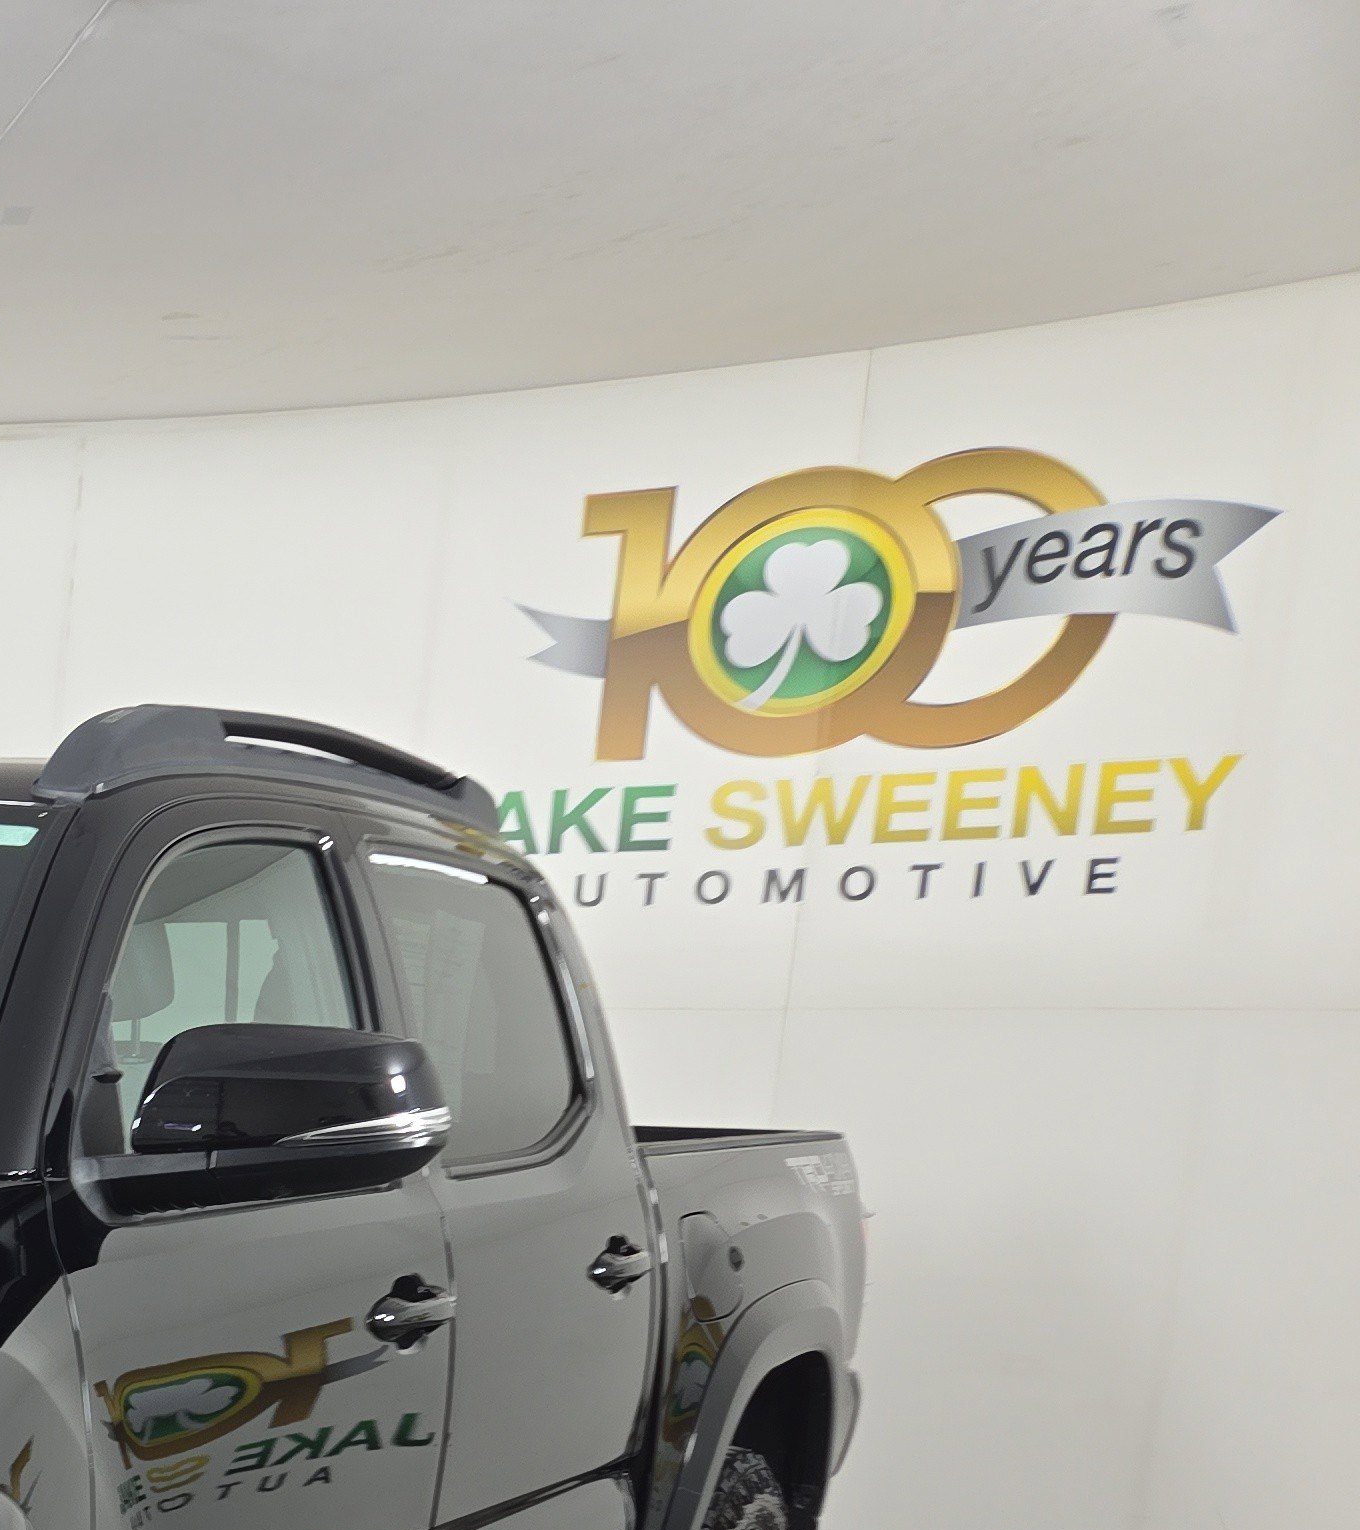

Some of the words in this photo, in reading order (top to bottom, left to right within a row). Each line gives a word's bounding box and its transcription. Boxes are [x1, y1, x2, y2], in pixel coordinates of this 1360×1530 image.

[582, 446, 1117, 762] 100
[971, 516, 1203, 613] years
[497, 783, 677, 855] AKE
[706, 753, 1244, 851] SWEENEY
[574, 856, 1123, 908] UTOMOTIVE
